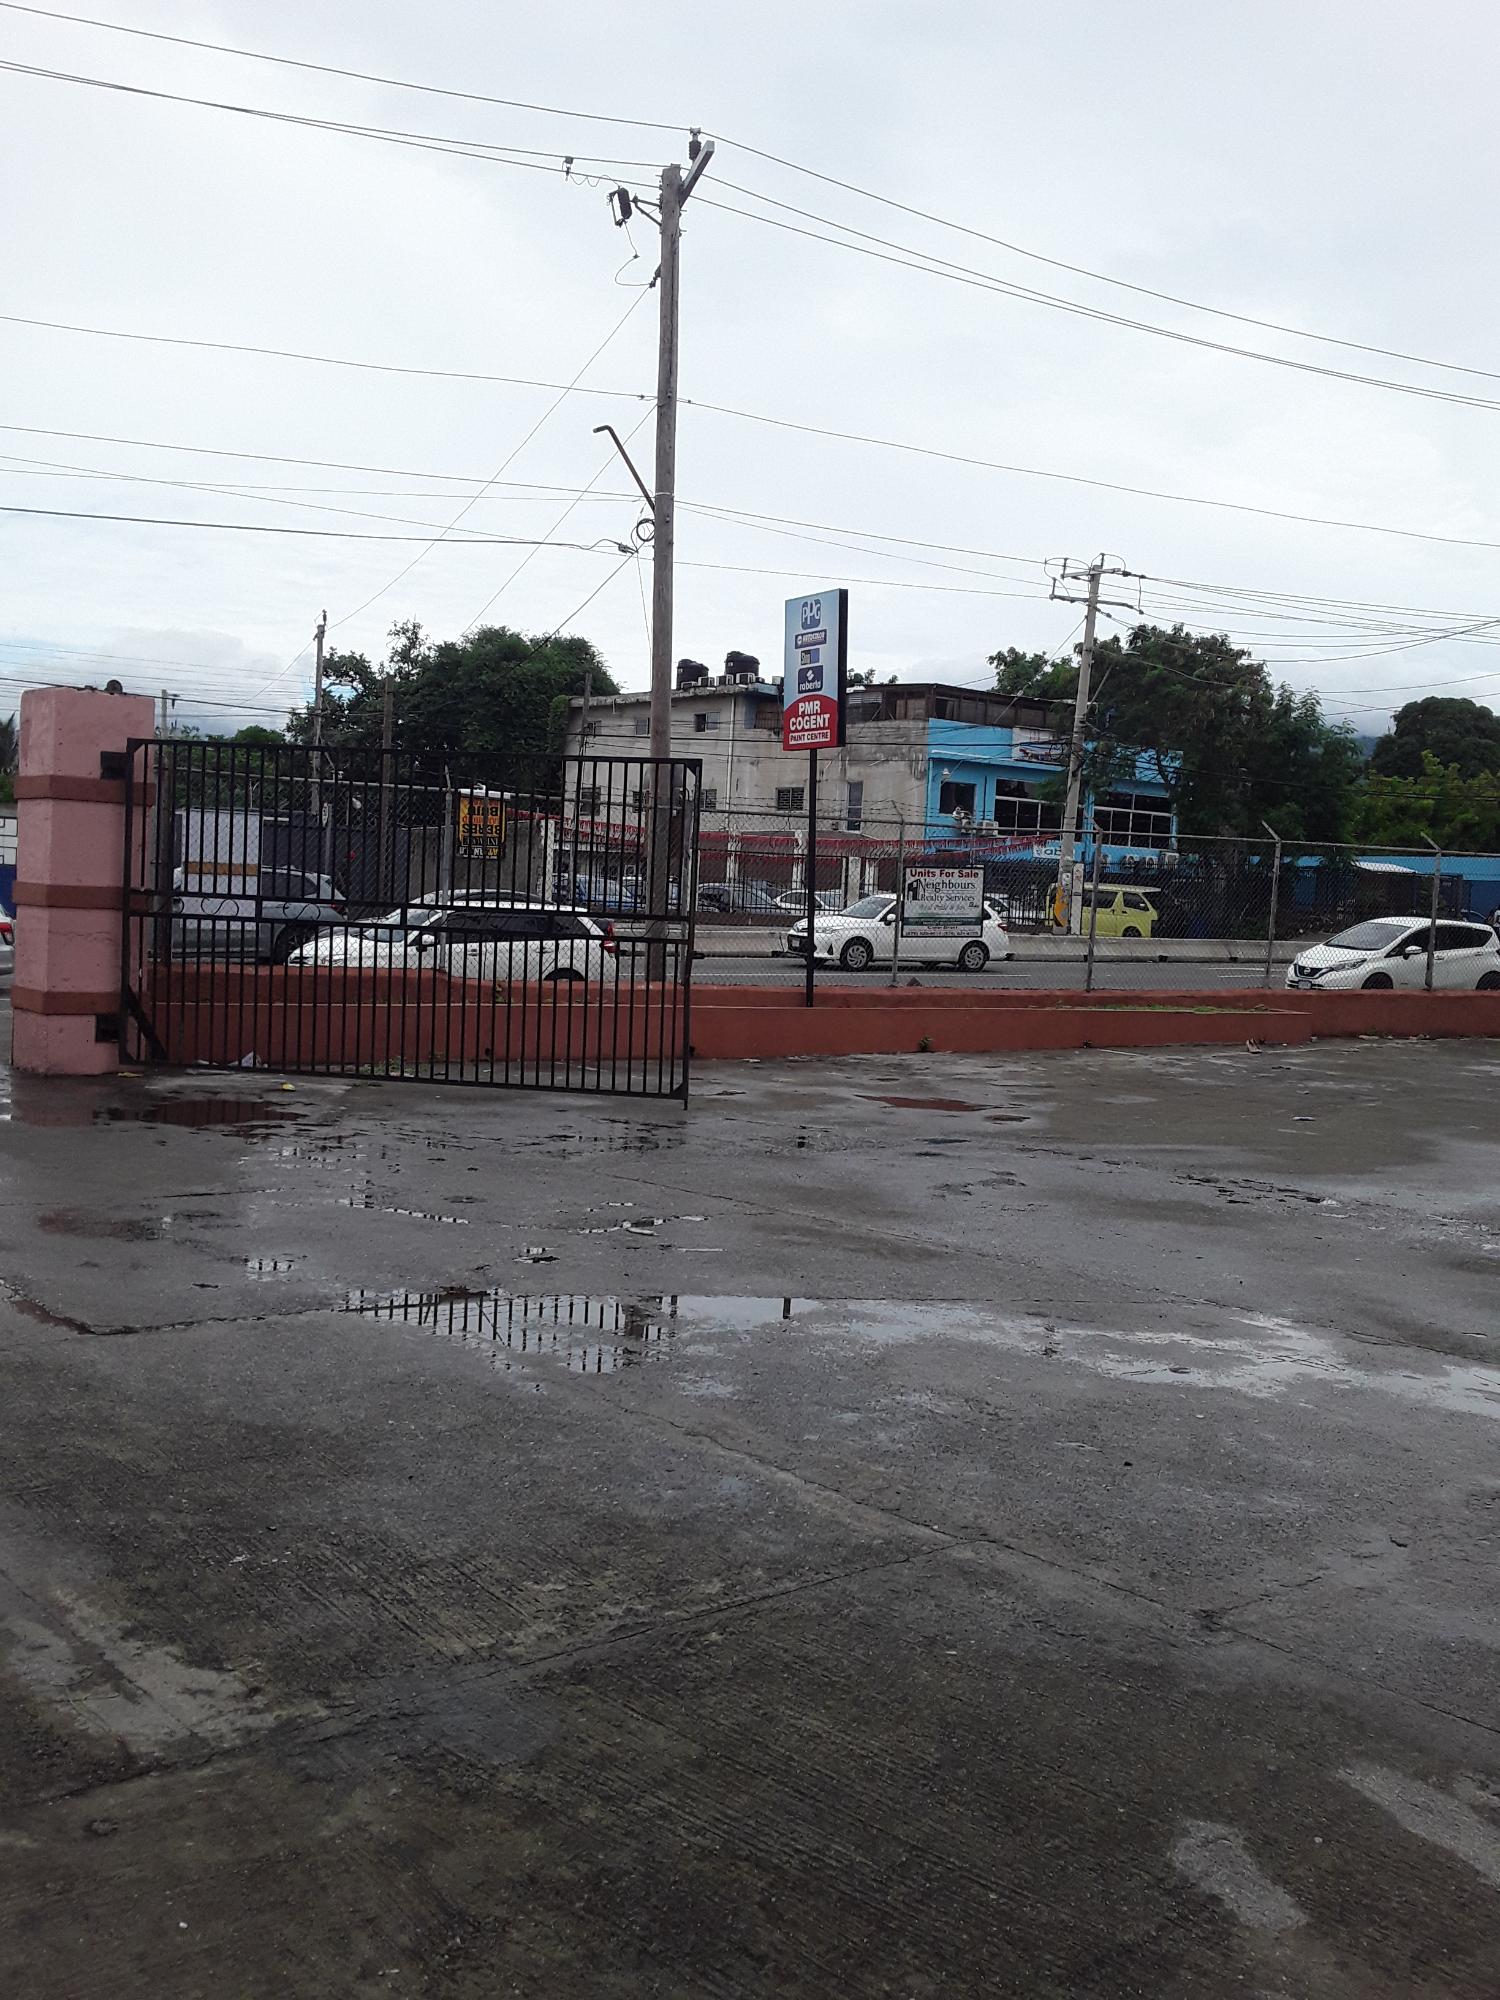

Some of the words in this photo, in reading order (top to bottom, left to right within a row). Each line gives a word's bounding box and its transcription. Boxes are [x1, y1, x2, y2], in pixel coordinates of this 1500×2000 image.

[802, 600, 821, 625] PPG
[798, 700, 821, 715] PMR
[789, 714, 830, 731] COGENT
[790, 733, 806, 742] PAINT
[807, 731, 829, 741] CENTRE
[910, 869, 936, 878] Units
[939, 869, 955, 878] For
[958, 869, 979, 878] Sale
[919, 878, 976, 894] Neighbours
[921, 894, 944, 903] Realty
[945, 894, 976, 902] Services
